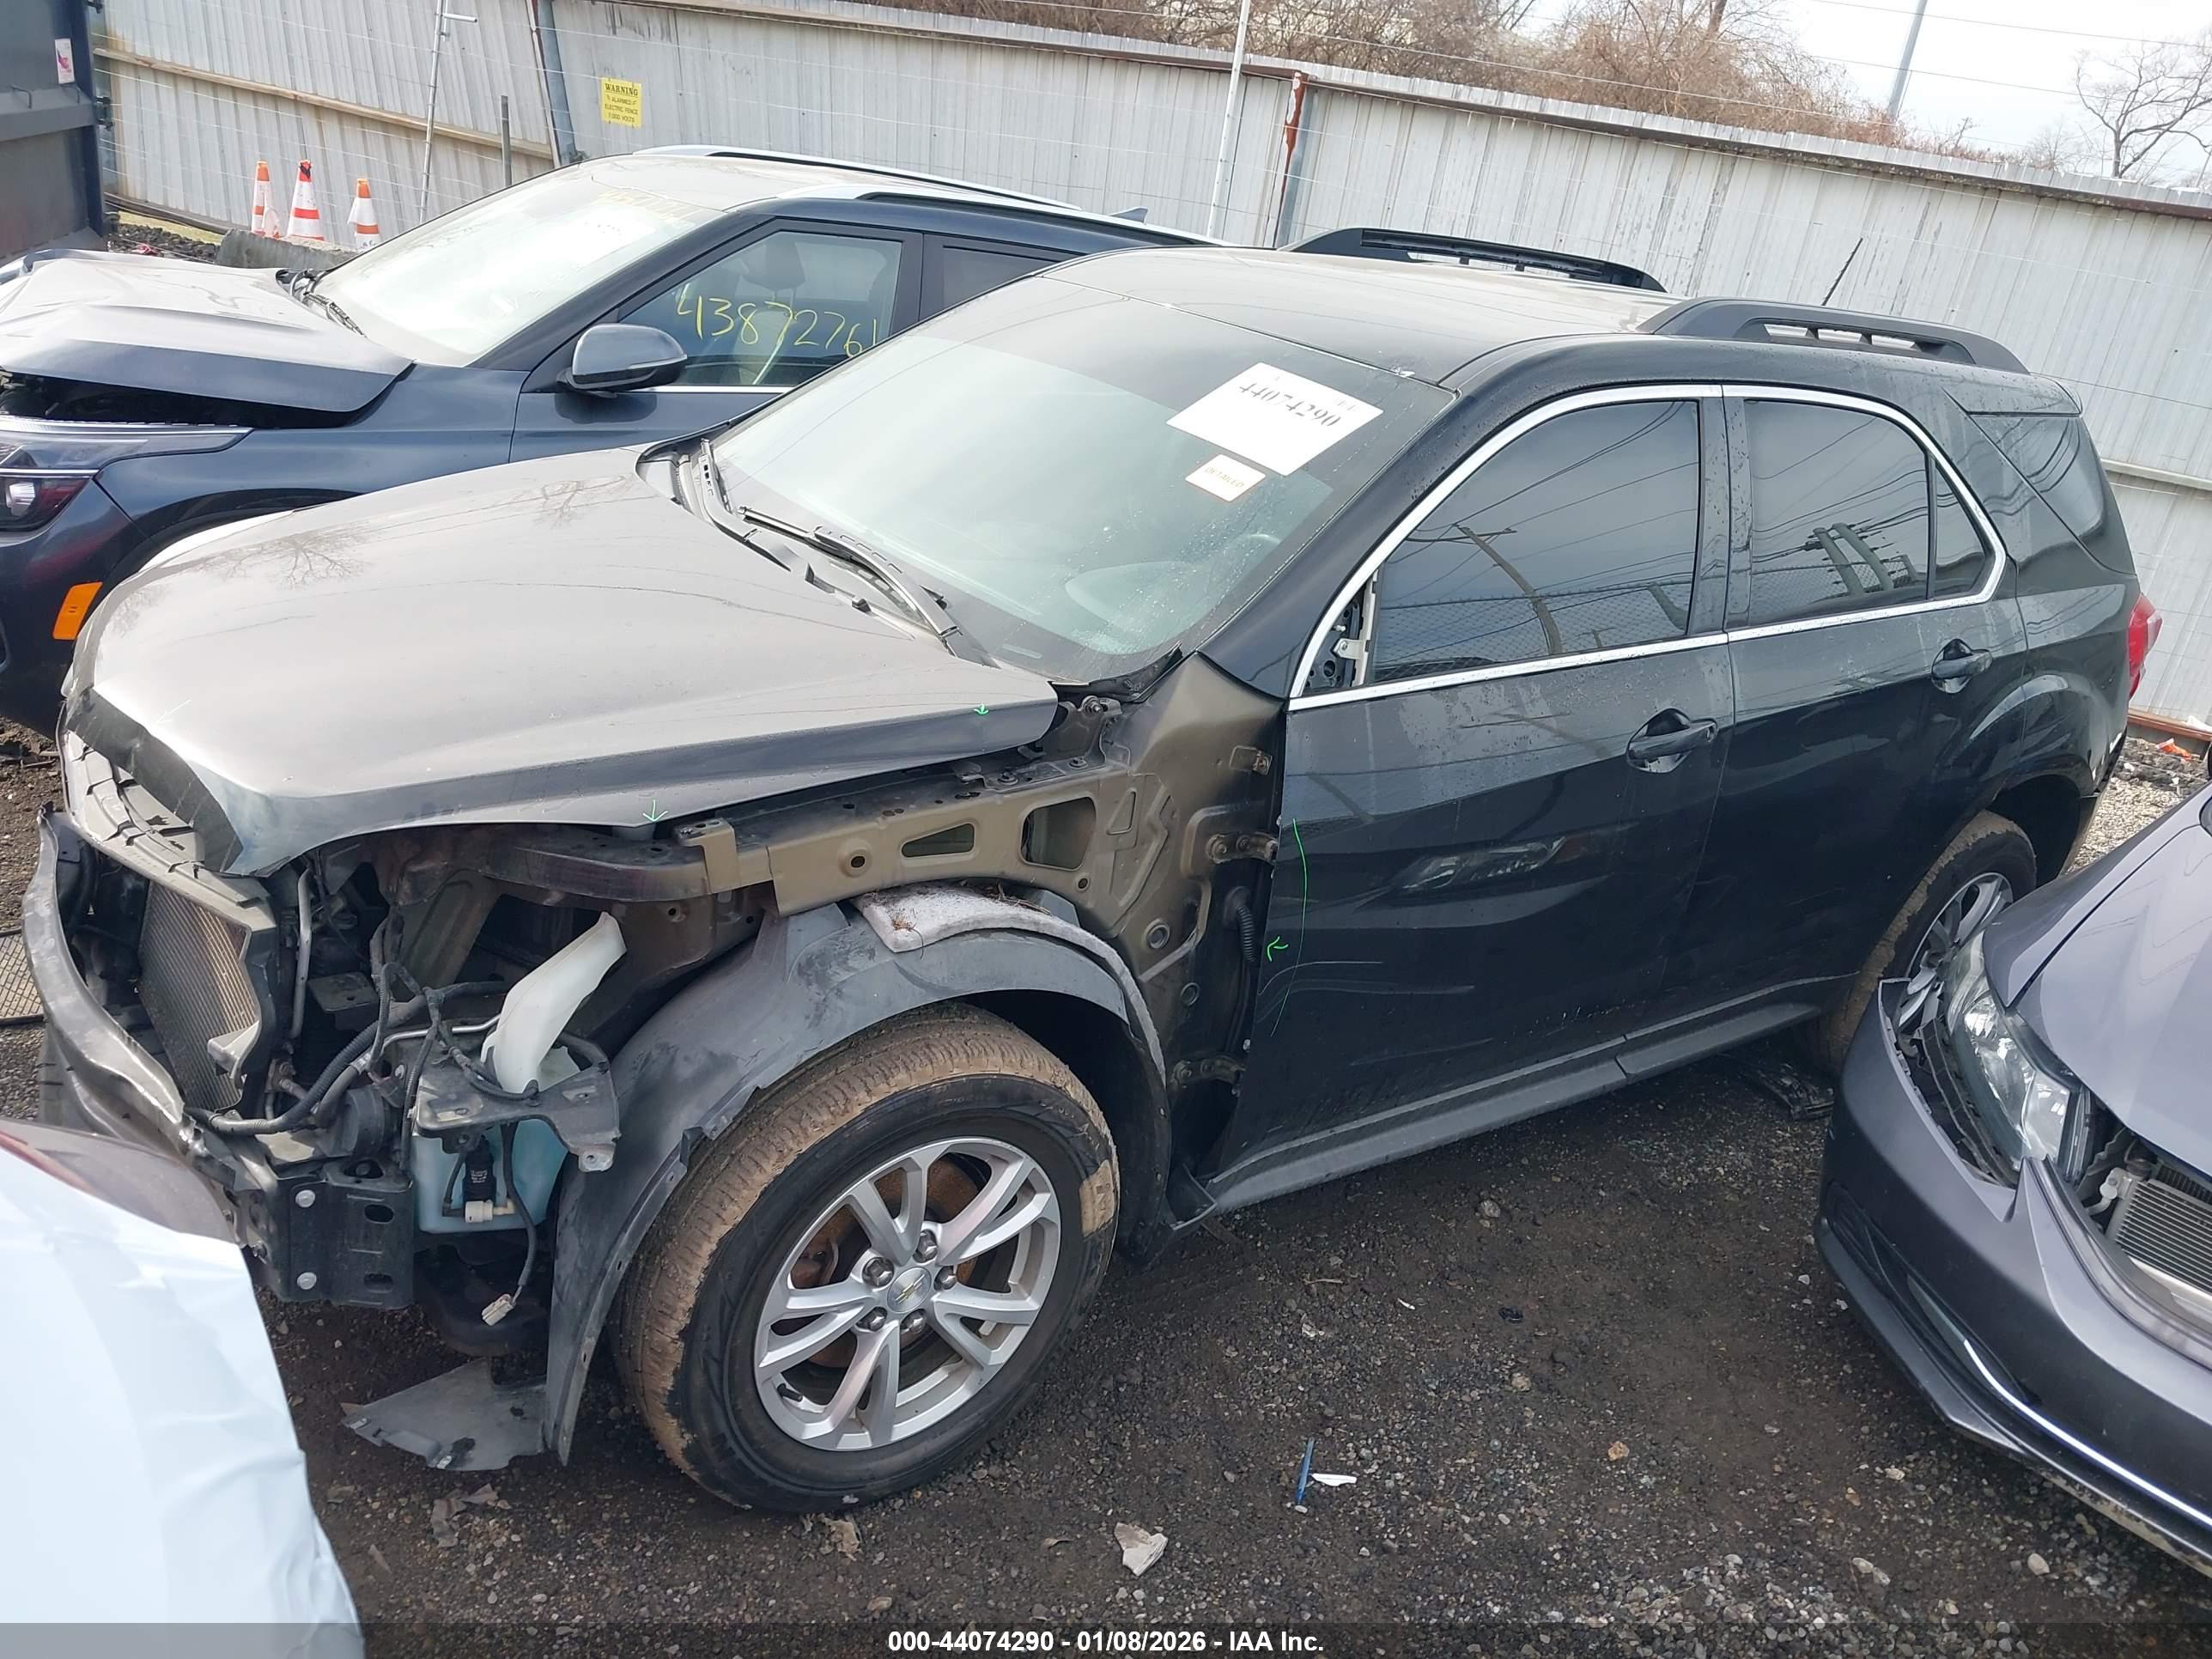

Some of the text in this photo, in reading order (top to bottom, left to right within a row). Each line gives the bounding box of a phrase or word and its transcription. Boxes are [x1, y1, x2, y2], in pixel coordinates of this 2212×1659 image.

[605, 83, 638, 96] WARNING
[605, 103, 624, 112] ELECTRIC
[677, 283, 878, 385] 43872761
